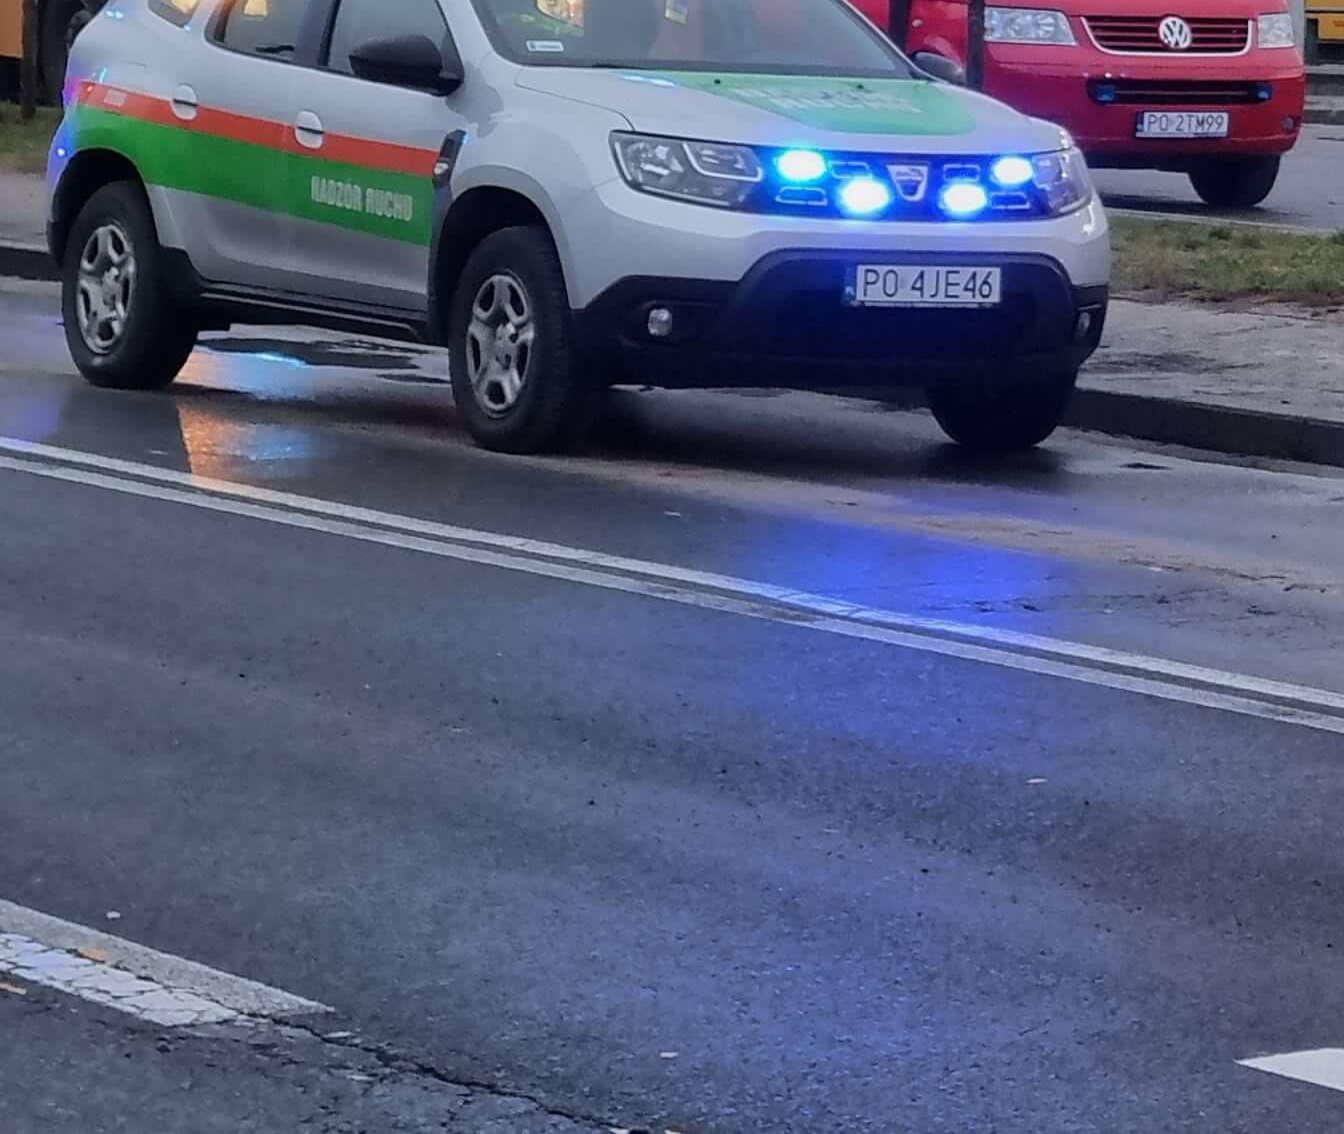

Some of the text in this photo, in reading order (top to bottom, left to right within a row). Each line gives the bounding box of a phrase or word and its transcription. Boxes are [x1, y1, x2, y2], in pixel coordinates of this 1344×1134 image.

[365, 187, 414, 222] RUCHU
[863, 268, 993, 299] PO 4JE46
